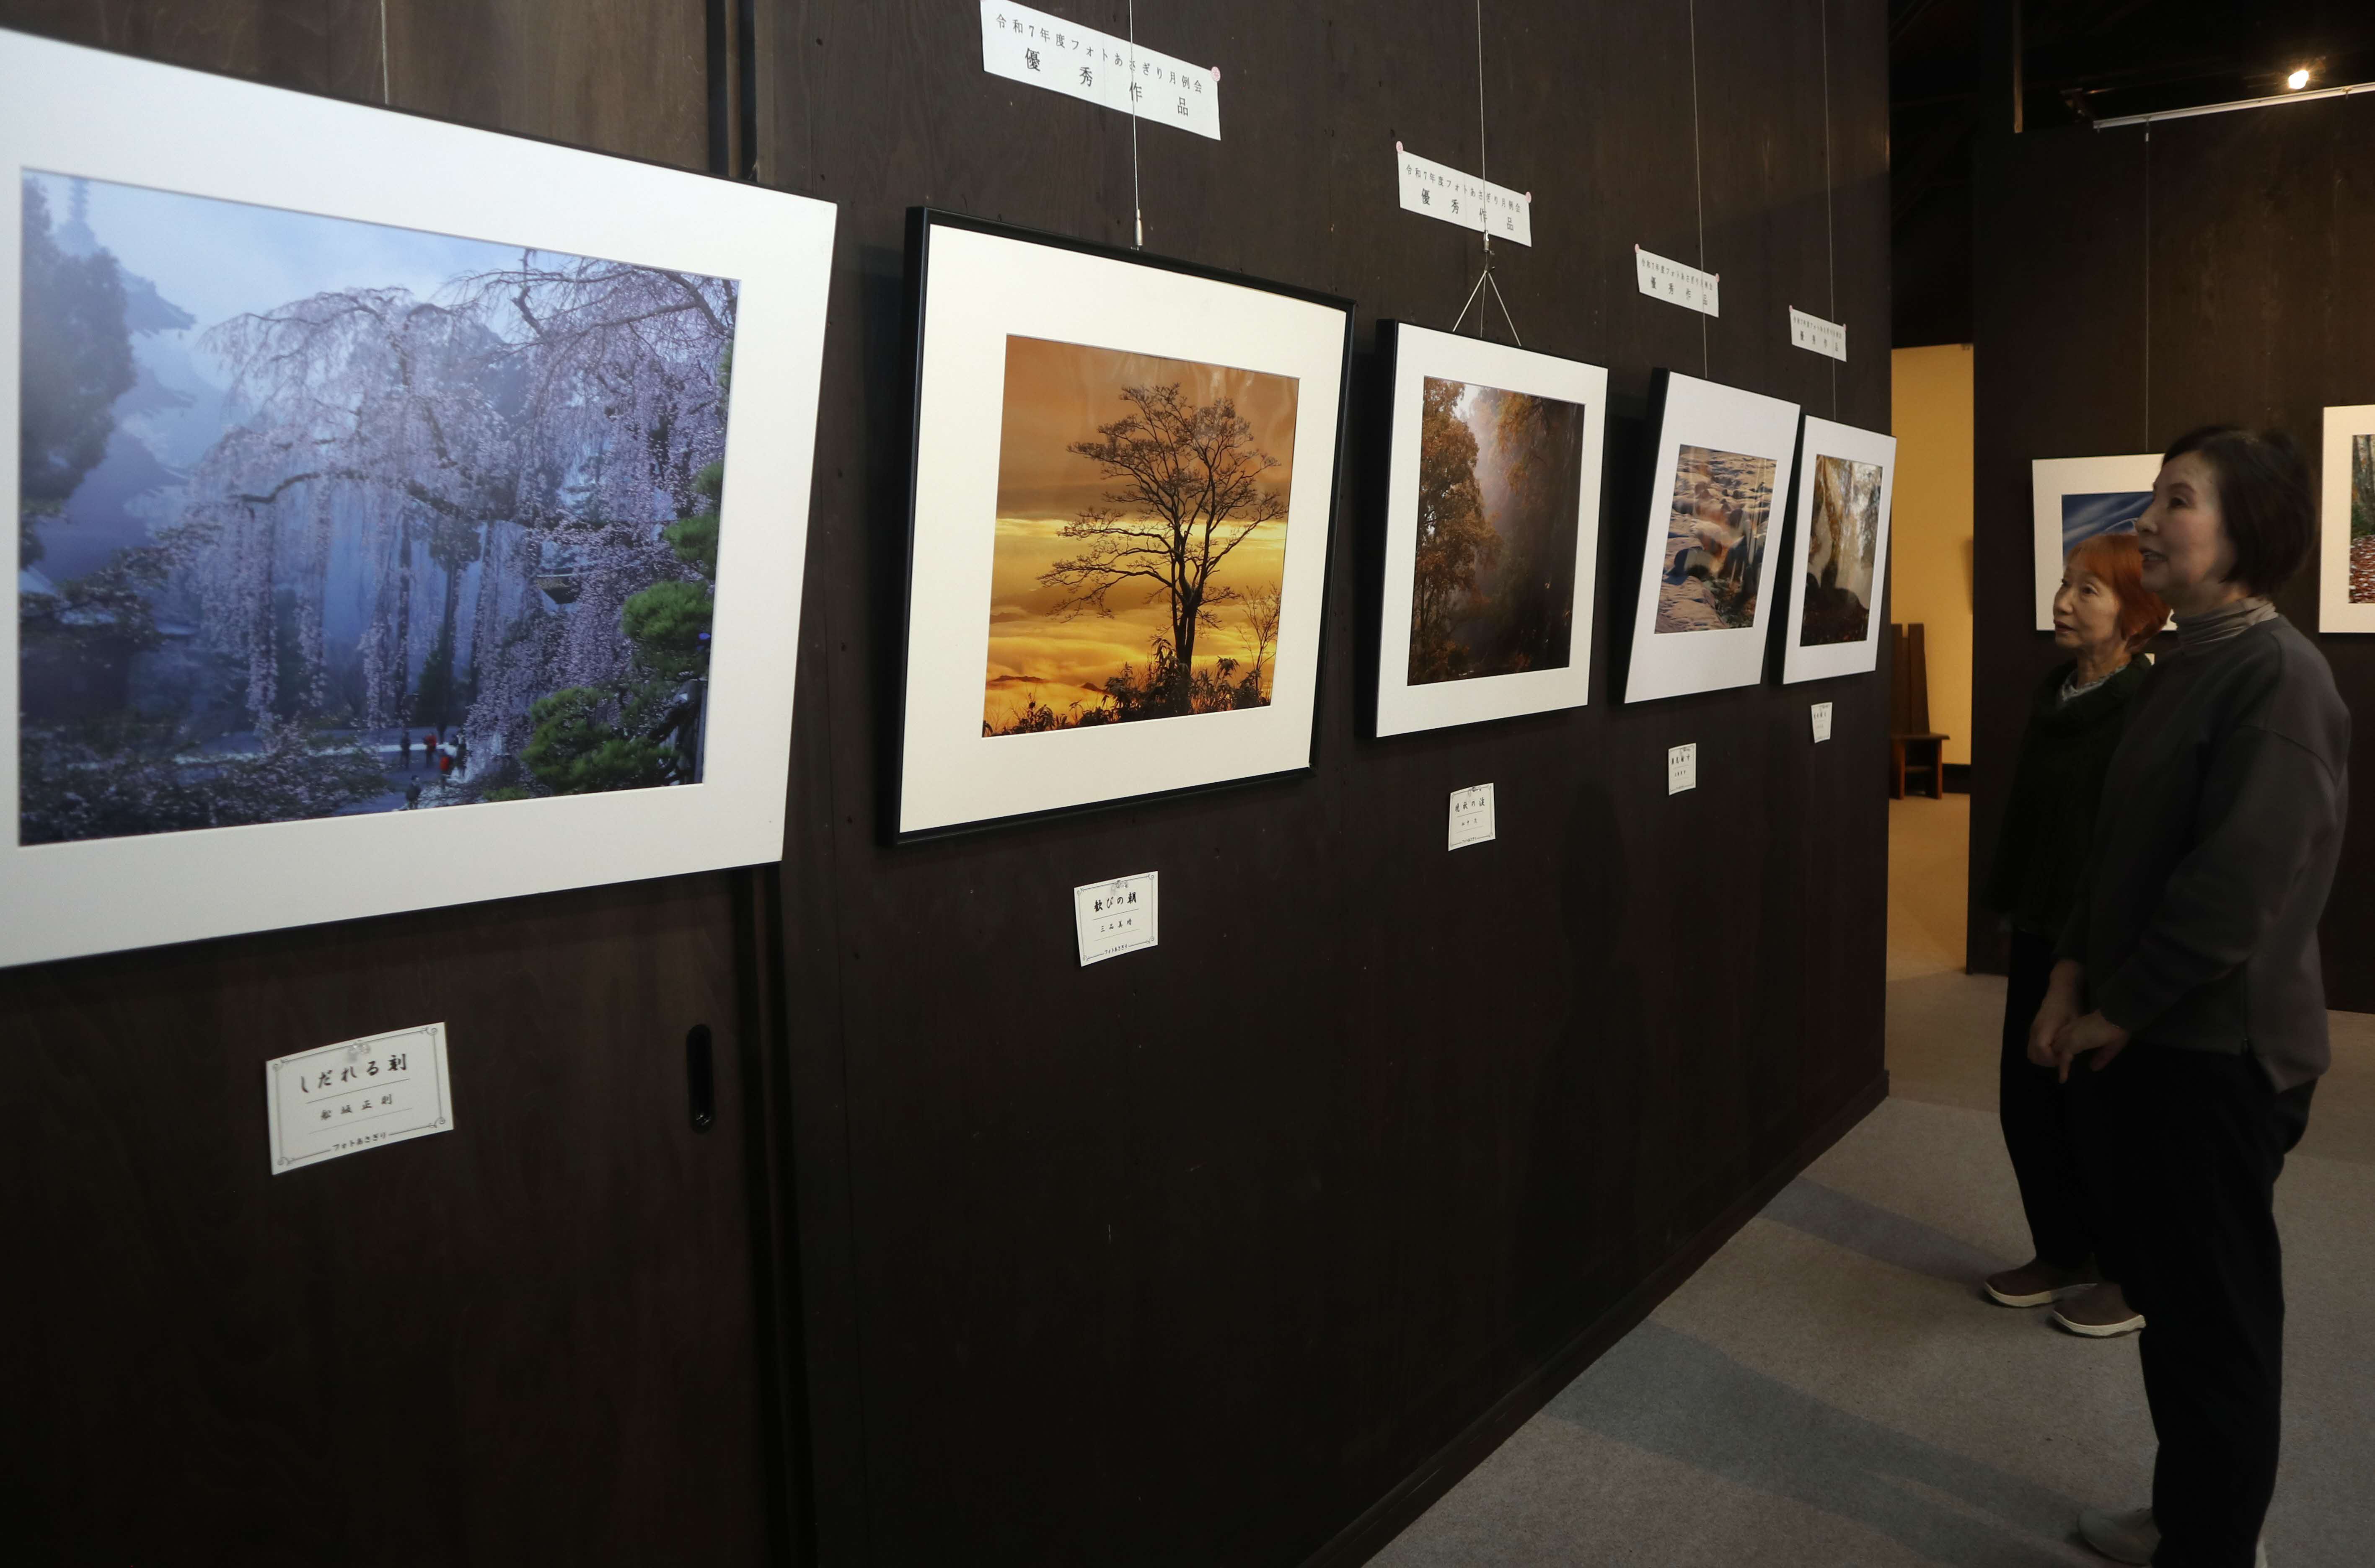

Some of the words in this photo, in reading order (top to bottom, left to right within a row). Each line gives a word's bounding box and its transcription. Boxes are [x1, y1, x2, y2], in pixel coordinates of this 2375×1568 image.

[1025, 47, 1189, 116] 優秀作品
[1094, 892, 1137, 912] 歓びの朝
[301, 1053, 407, 1093] しだれる刻
[332, 1132, 386, 1150] フォトあさぎり
